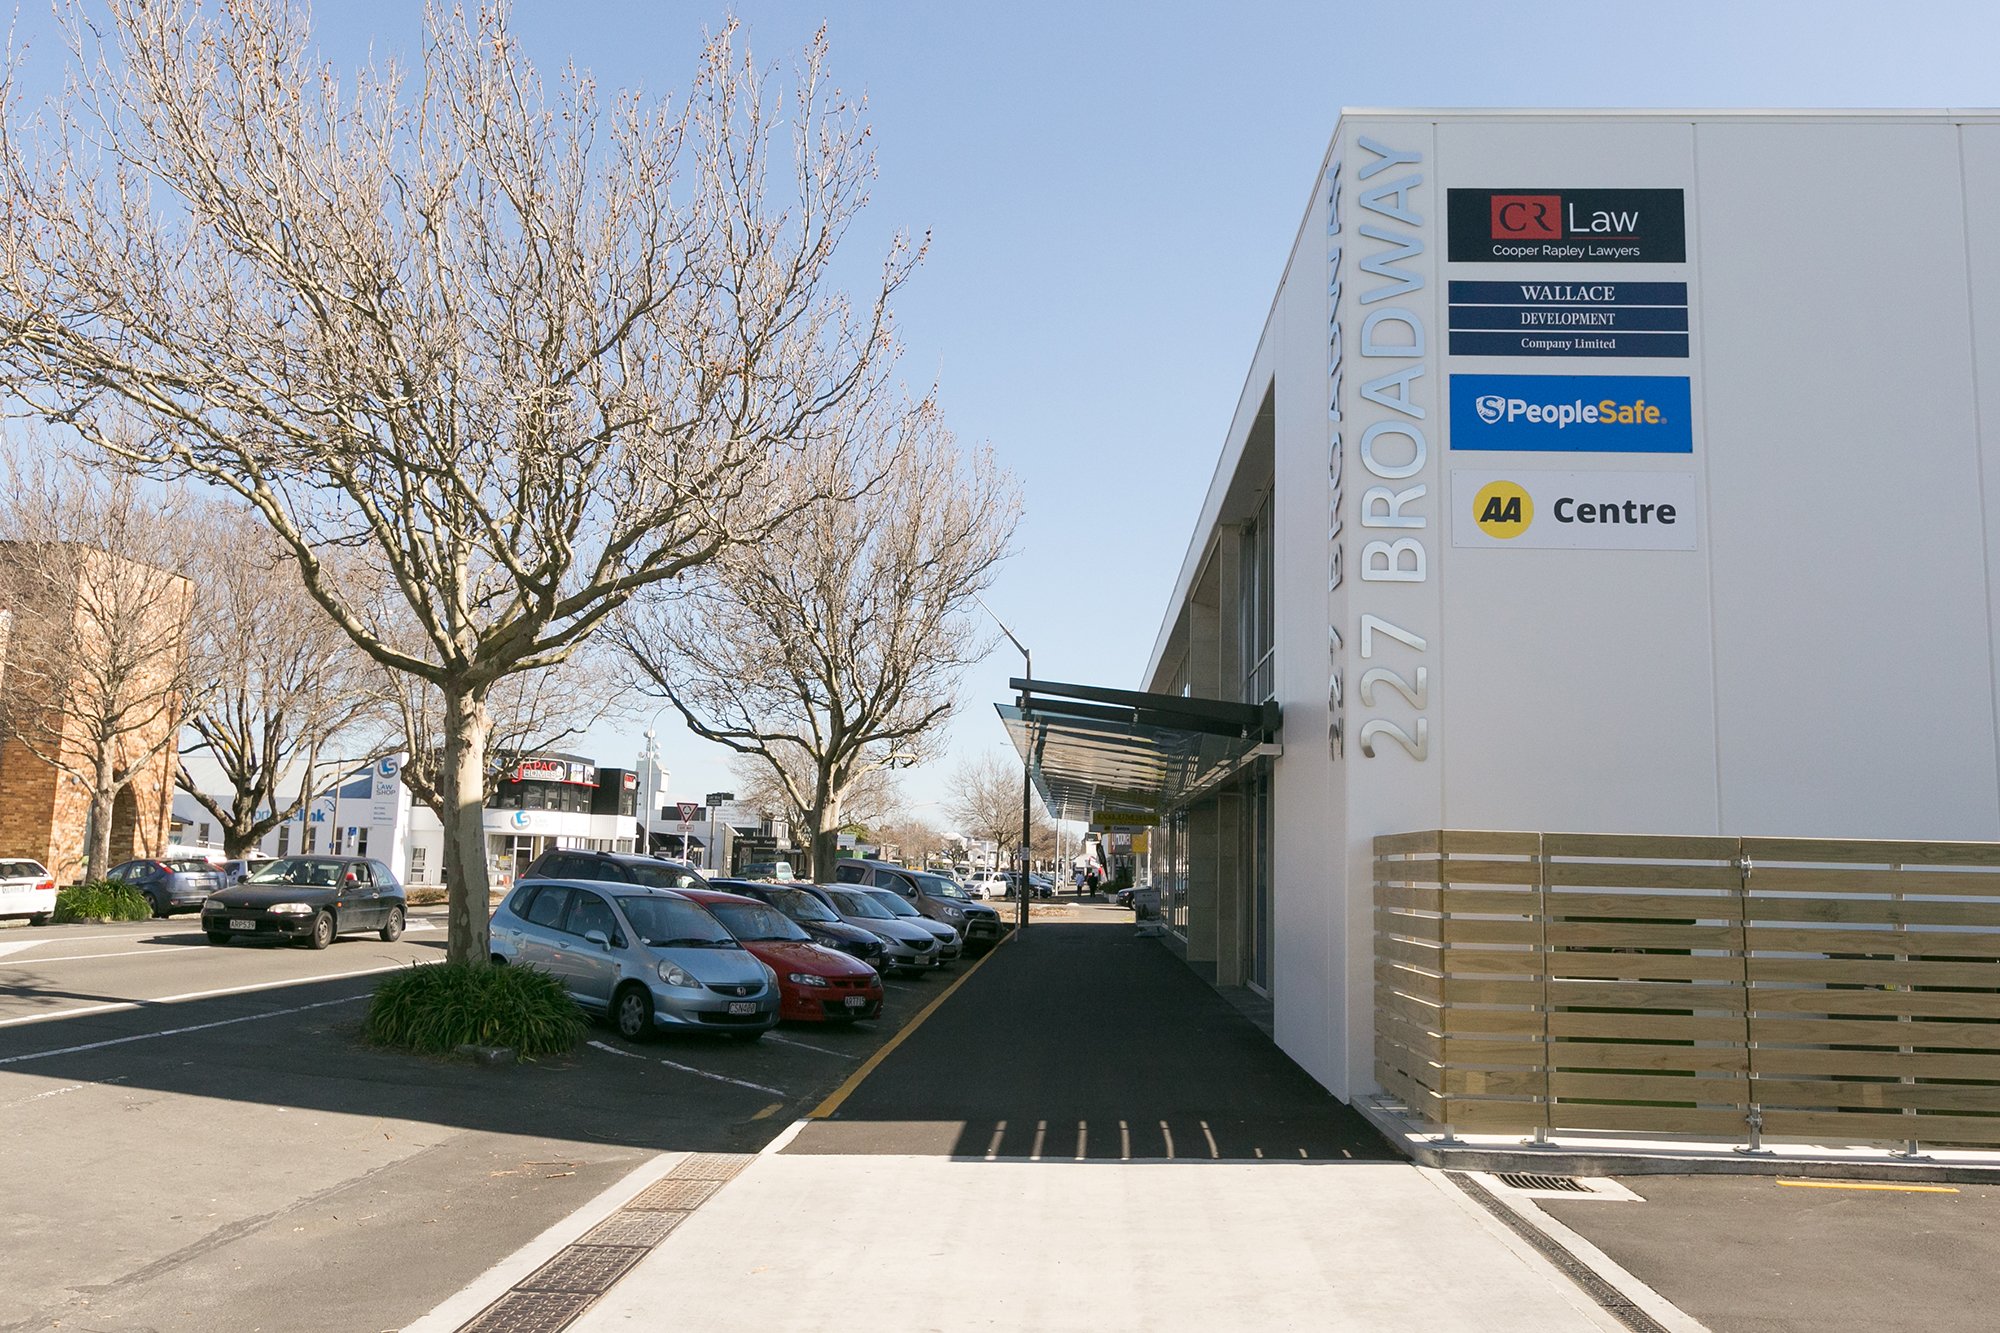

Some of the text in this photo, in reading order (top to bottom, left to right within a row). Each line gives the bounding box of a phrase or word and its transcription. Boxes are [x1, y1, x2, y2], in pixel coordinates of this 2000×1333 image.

[1498, 202, 1639, 233] CR Law
[1492, 244, 1640, 258] Cooper Rapley Lawyers
[1520, 286, 1615, 302] WALLACE
[1520, 311, 1615, 326] DEVELOPMENT
[1520, 337, 1616, 351] Company Limited
[1358, 136, 1427, 762] 227 BROADWAY
[1480, 497, 1677, 525] AA Centre
